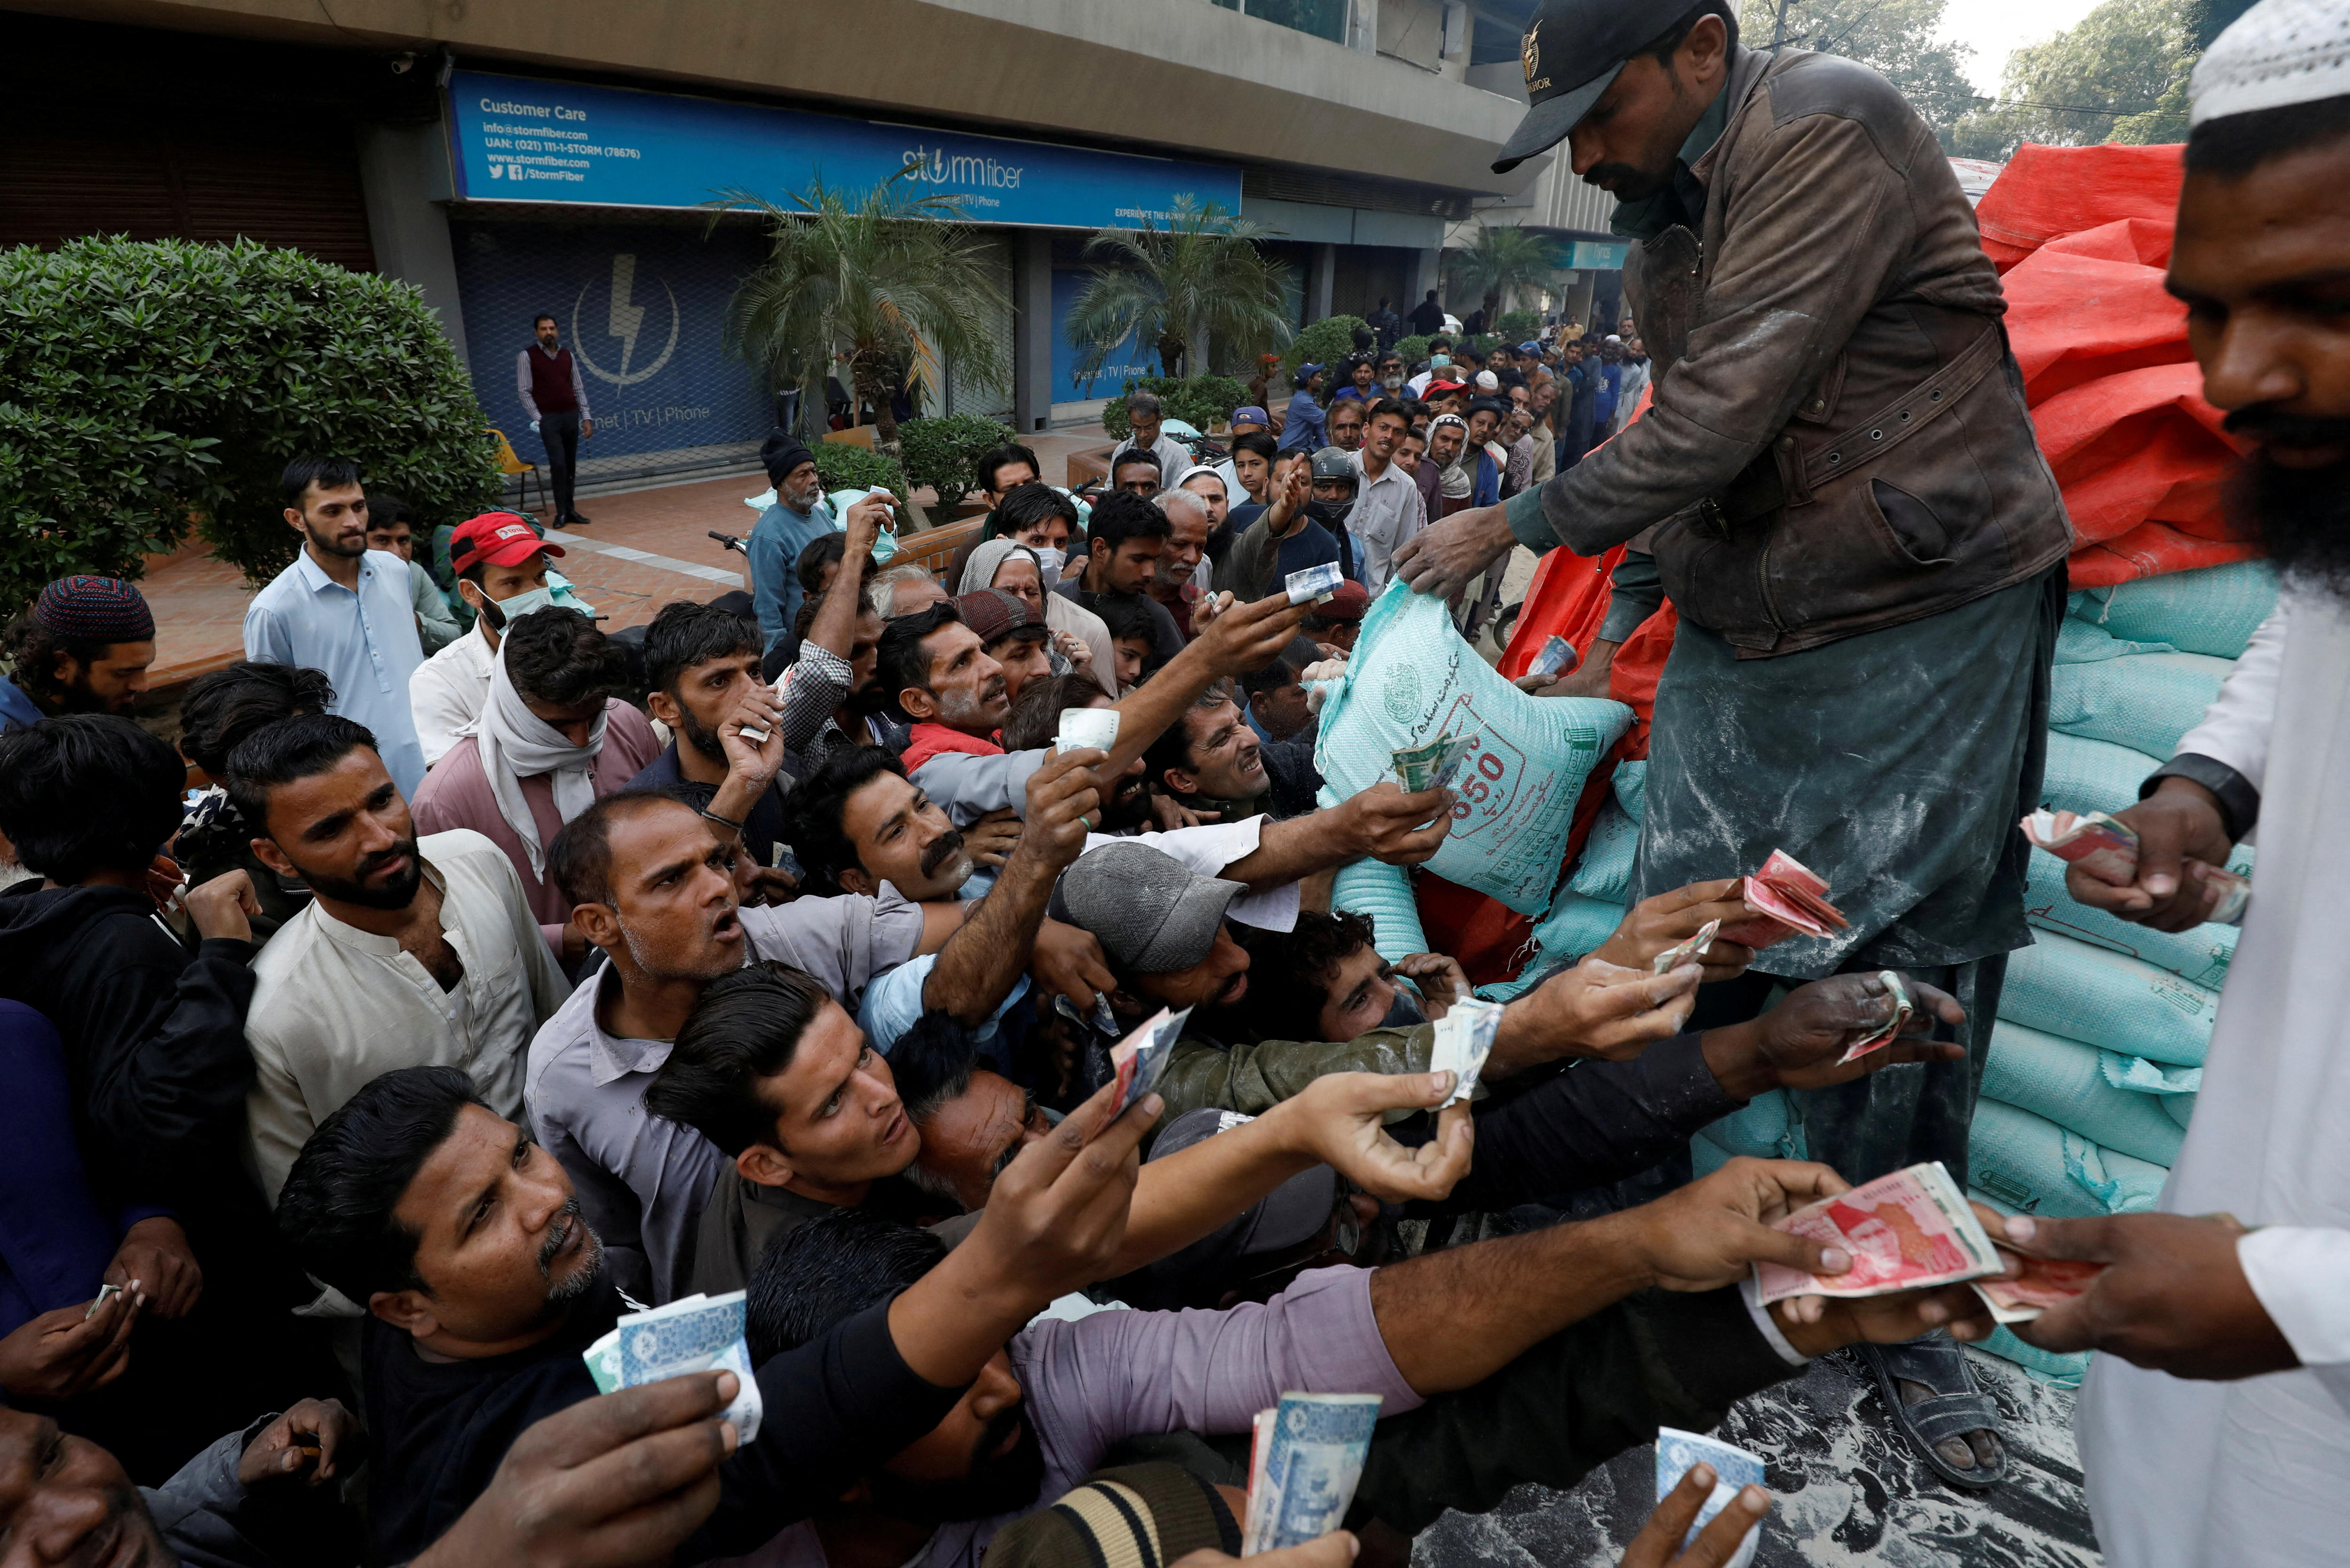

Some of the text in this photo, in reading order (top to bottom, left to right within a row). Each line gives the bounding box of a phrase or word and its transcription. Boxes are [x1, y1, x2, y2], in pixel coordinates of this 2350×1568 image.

[480, 98, 586, 121] Customer Care
[483, 122, 588, 141] info@stormfiber.com
[485, 137, 641, 159] UAN: (021) 111-1-STORM (78676)
[487, 154, 590, 168] www.stormfiber.com
[525, 168, 584, 182] /StormFiber
[979, 196, 1000, 207] Phone
[1115, 208, 1152, 219] EXPERIENCE
[1153, 211, 1164, 220] THE
[1108, 366, 1118, 377] TV
[1124, 365, 1145, 376] Phone
[631, 409, 654, 425] TV
[665, 406, 710, 422] Phone
[1918, 1244, 1967, 1273] 100
